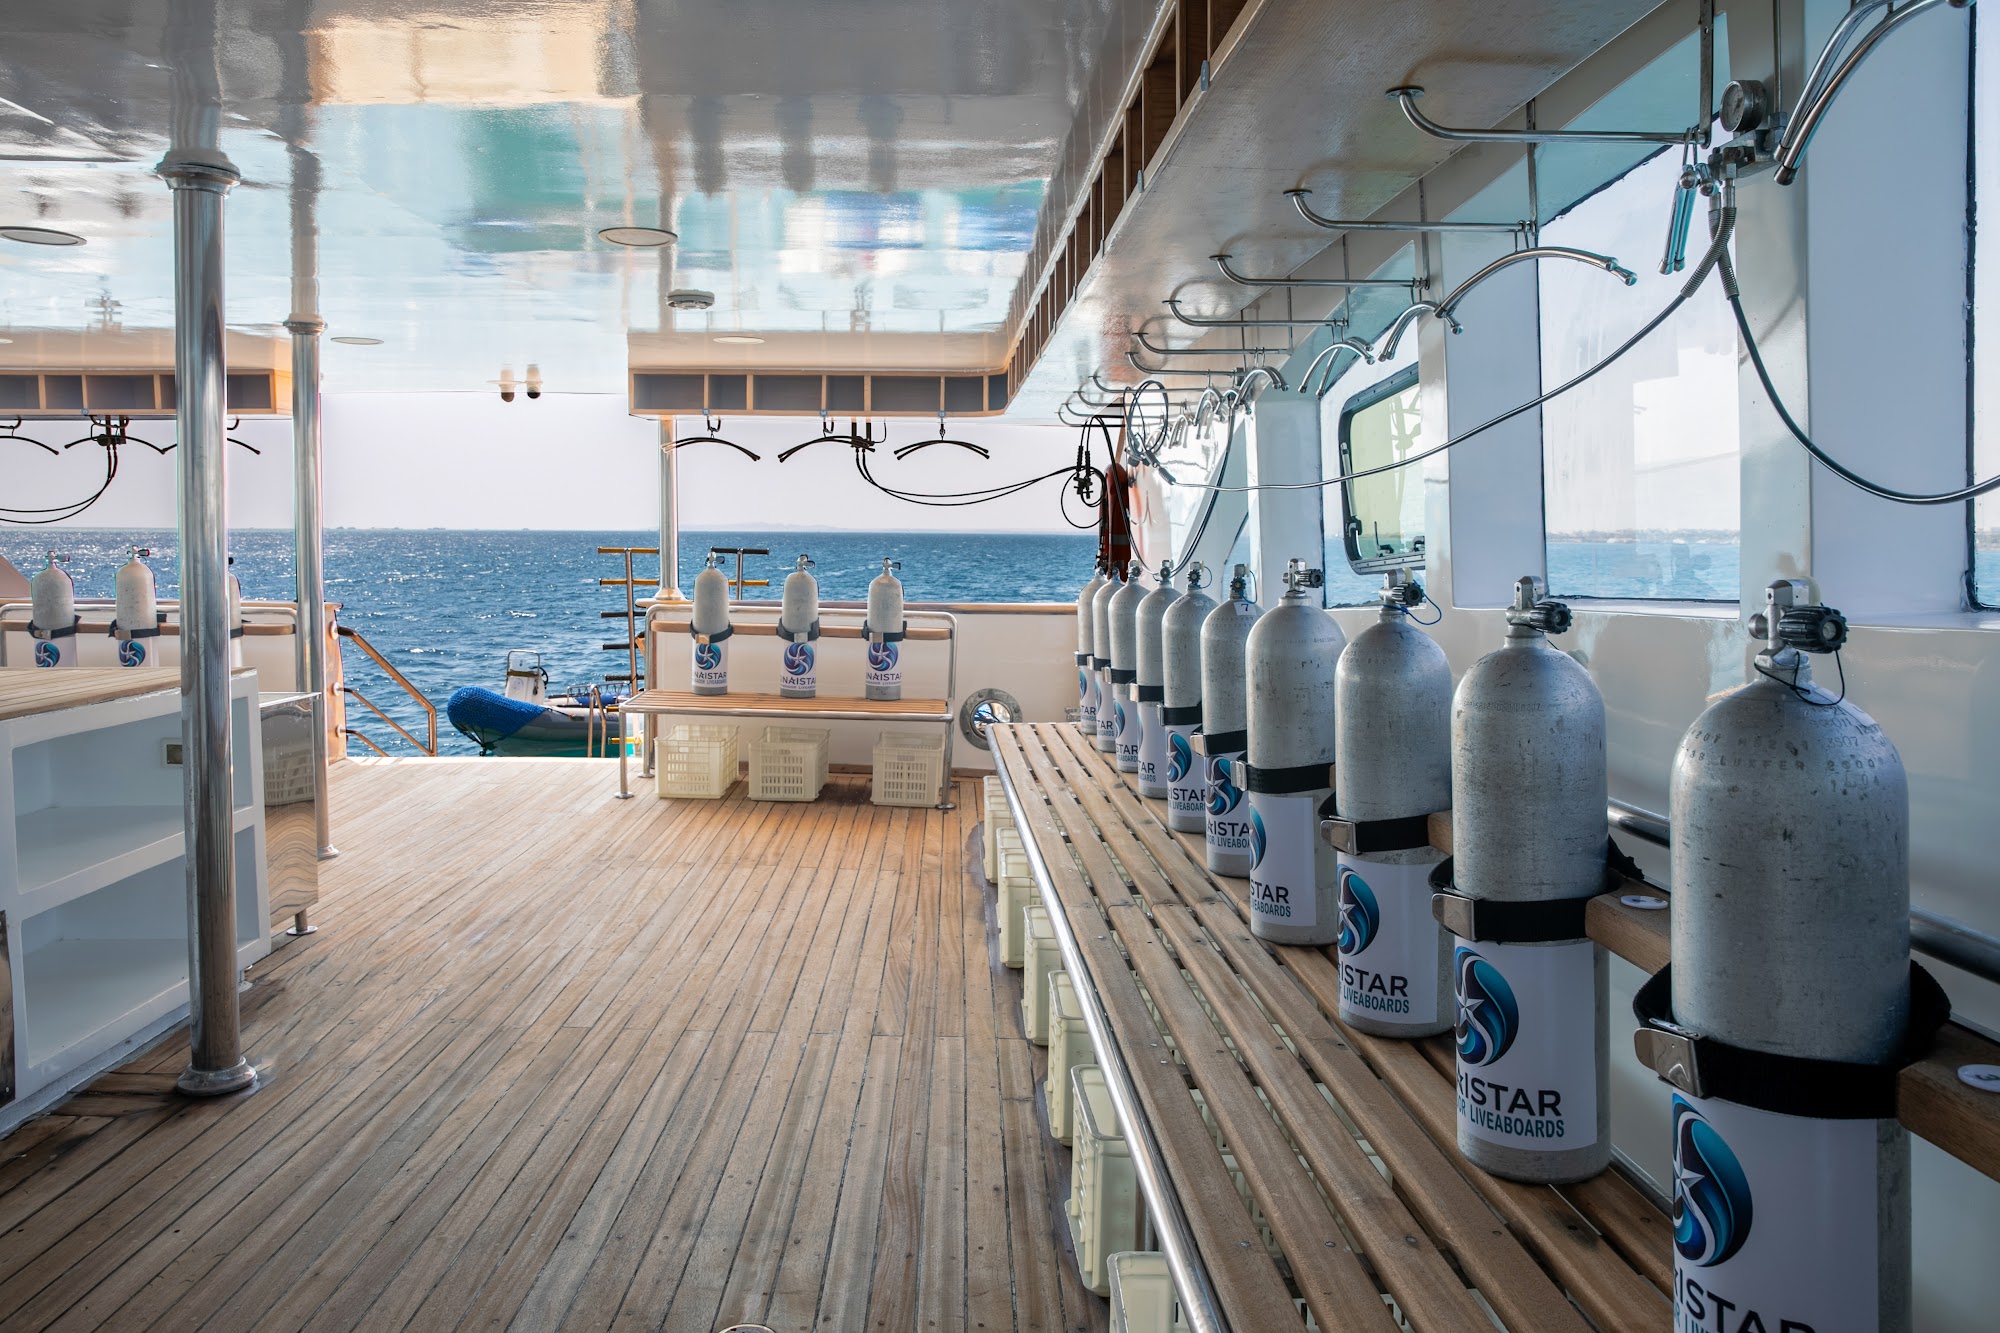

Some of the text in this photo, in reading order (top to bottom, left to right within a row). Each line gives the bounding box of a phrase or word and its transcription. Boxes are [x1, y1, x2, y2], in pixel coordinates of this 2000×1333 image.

[1240, 603, 1249, 612] 7
[1343, 984, 1410, 1014] LIVEABOARDS
[1470, 1104, 1565, 1138] LIVEABOARDS
